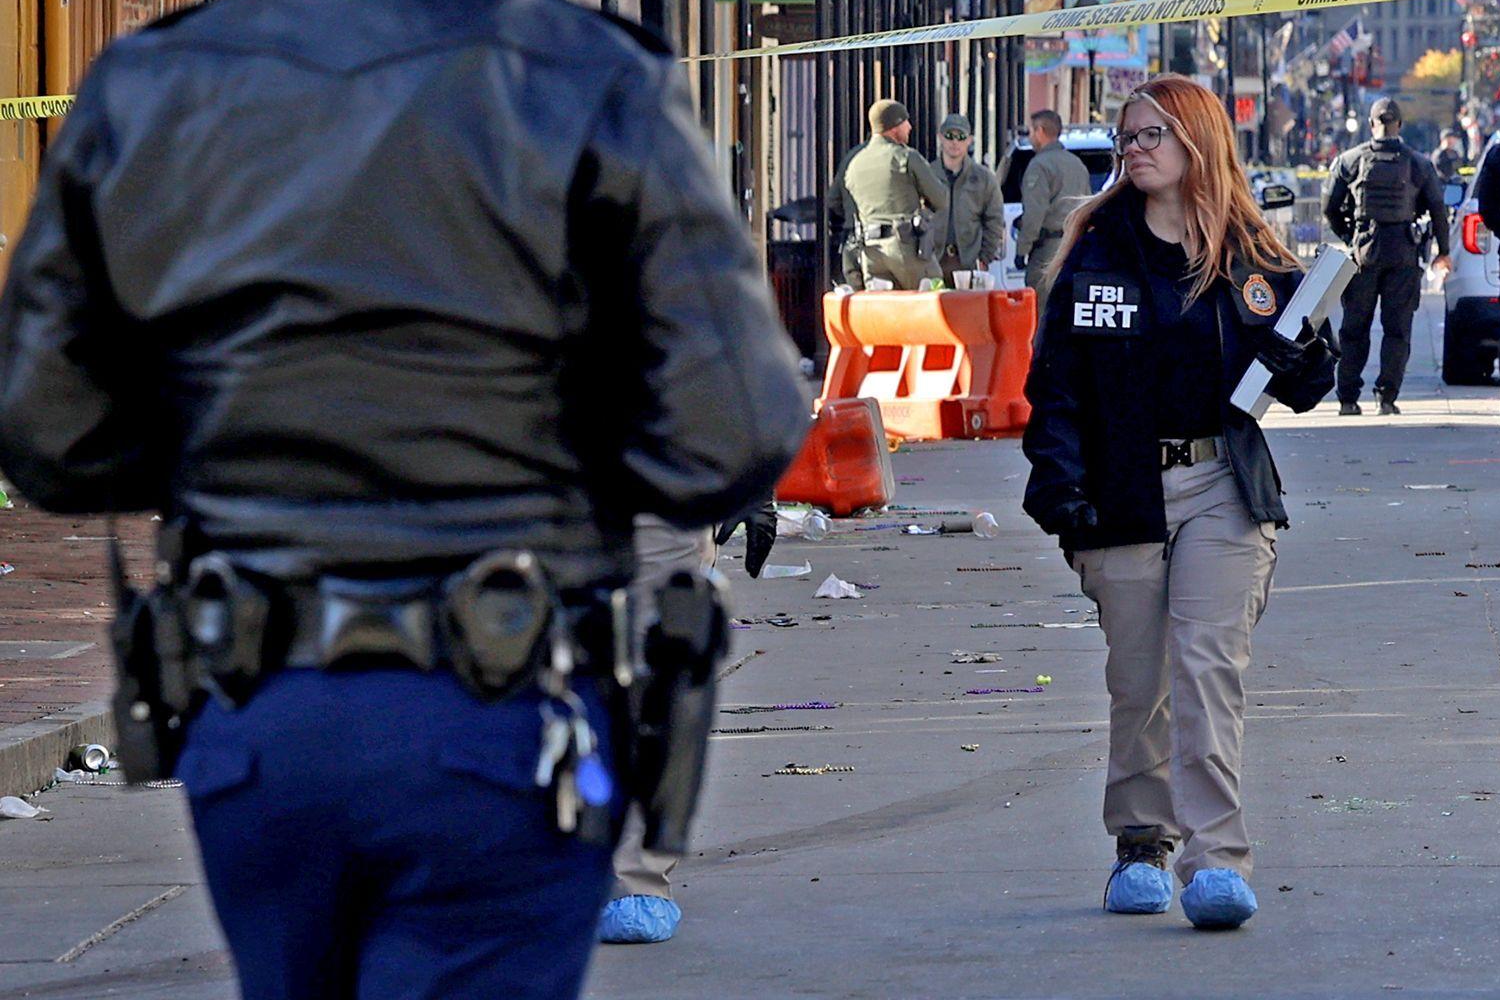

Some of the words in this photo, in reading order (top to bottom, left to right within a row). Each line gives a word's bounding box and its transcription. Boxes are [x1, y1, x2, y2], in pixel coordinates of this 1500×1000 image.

[1042, 5, 1089, 30] CRIME
[1086, 4, 1133, 27] SCENE
[1131, 2, 1154, 23] DO
[1149, 0, 1185, 20] NOT
[1089, 285, 1124, 303] FBI
[1073, 302, 1138, 329] ERT
